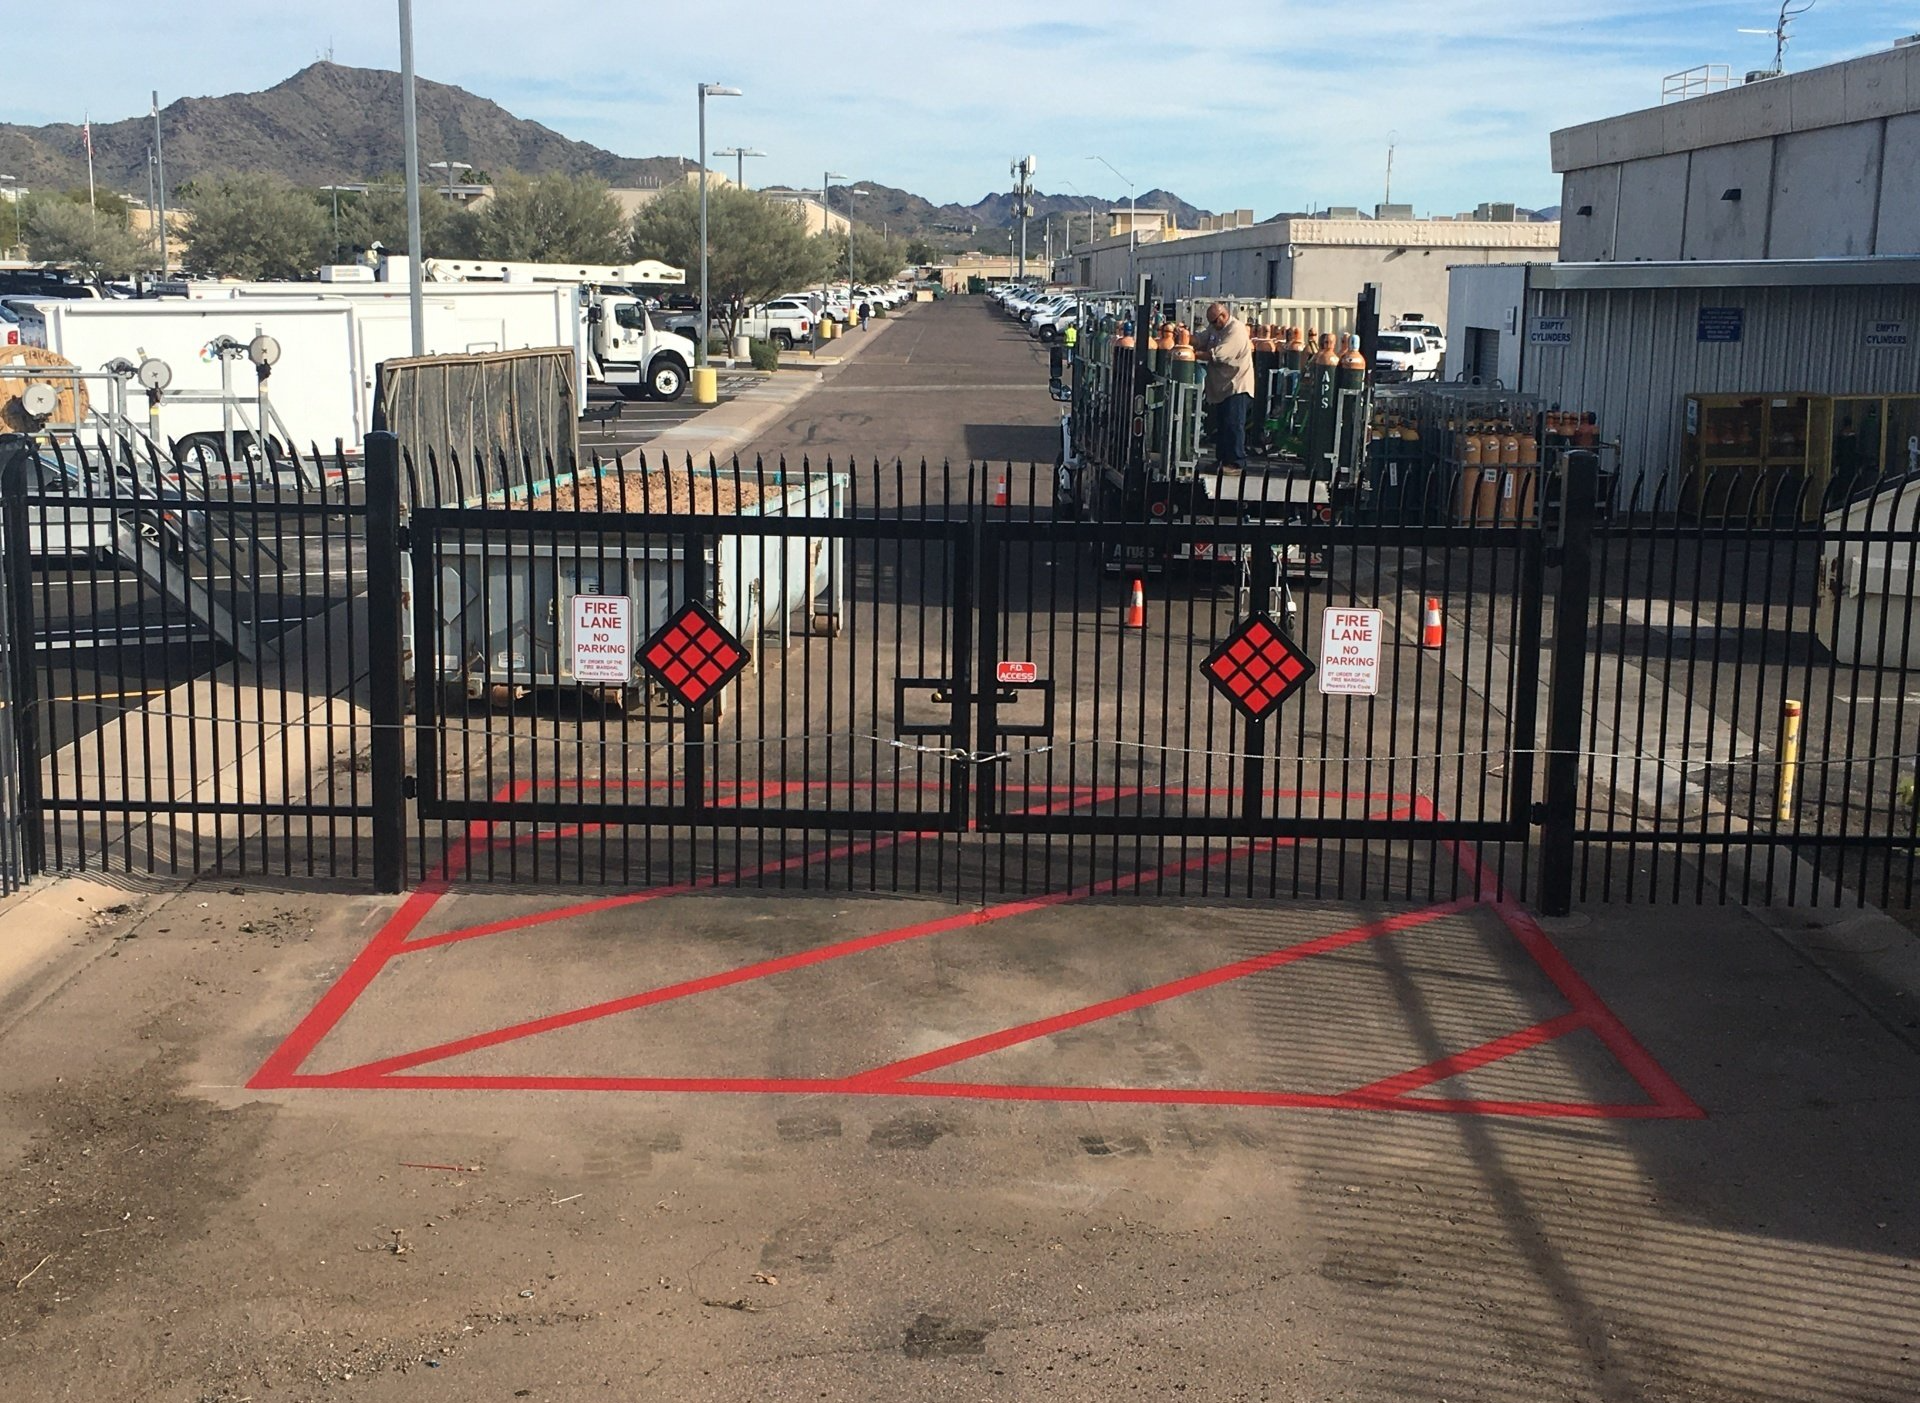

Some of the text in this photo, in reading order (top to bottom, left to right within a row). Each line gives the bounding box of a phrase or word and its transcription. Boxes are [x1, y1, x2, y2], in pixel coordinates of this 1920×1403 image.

[1540, 321, 1564, 330] EMPTY
[1876, 323, 1900, 332] EMPTY
[1531, 332, 1571, 342] CYLINDERS
[1866, 335, 1907, 344] CYLINDERS
[1321, 370, 1330, 409] APS
[585, 602, 618, 615] FIRE
[581, 616, 622, 629] LANE
[1336, 614, 1369, 627] FIRE
[593, 633, 609, 642] NO
[1331, 629, 1372, 642] LANE
[577, 644, 626, 654] PARKING
[1343, 646, 1359, 655] NO
[1326, 656, 1374, 667] PARKING
[1000, 672, 1034, 680] ACCESS
